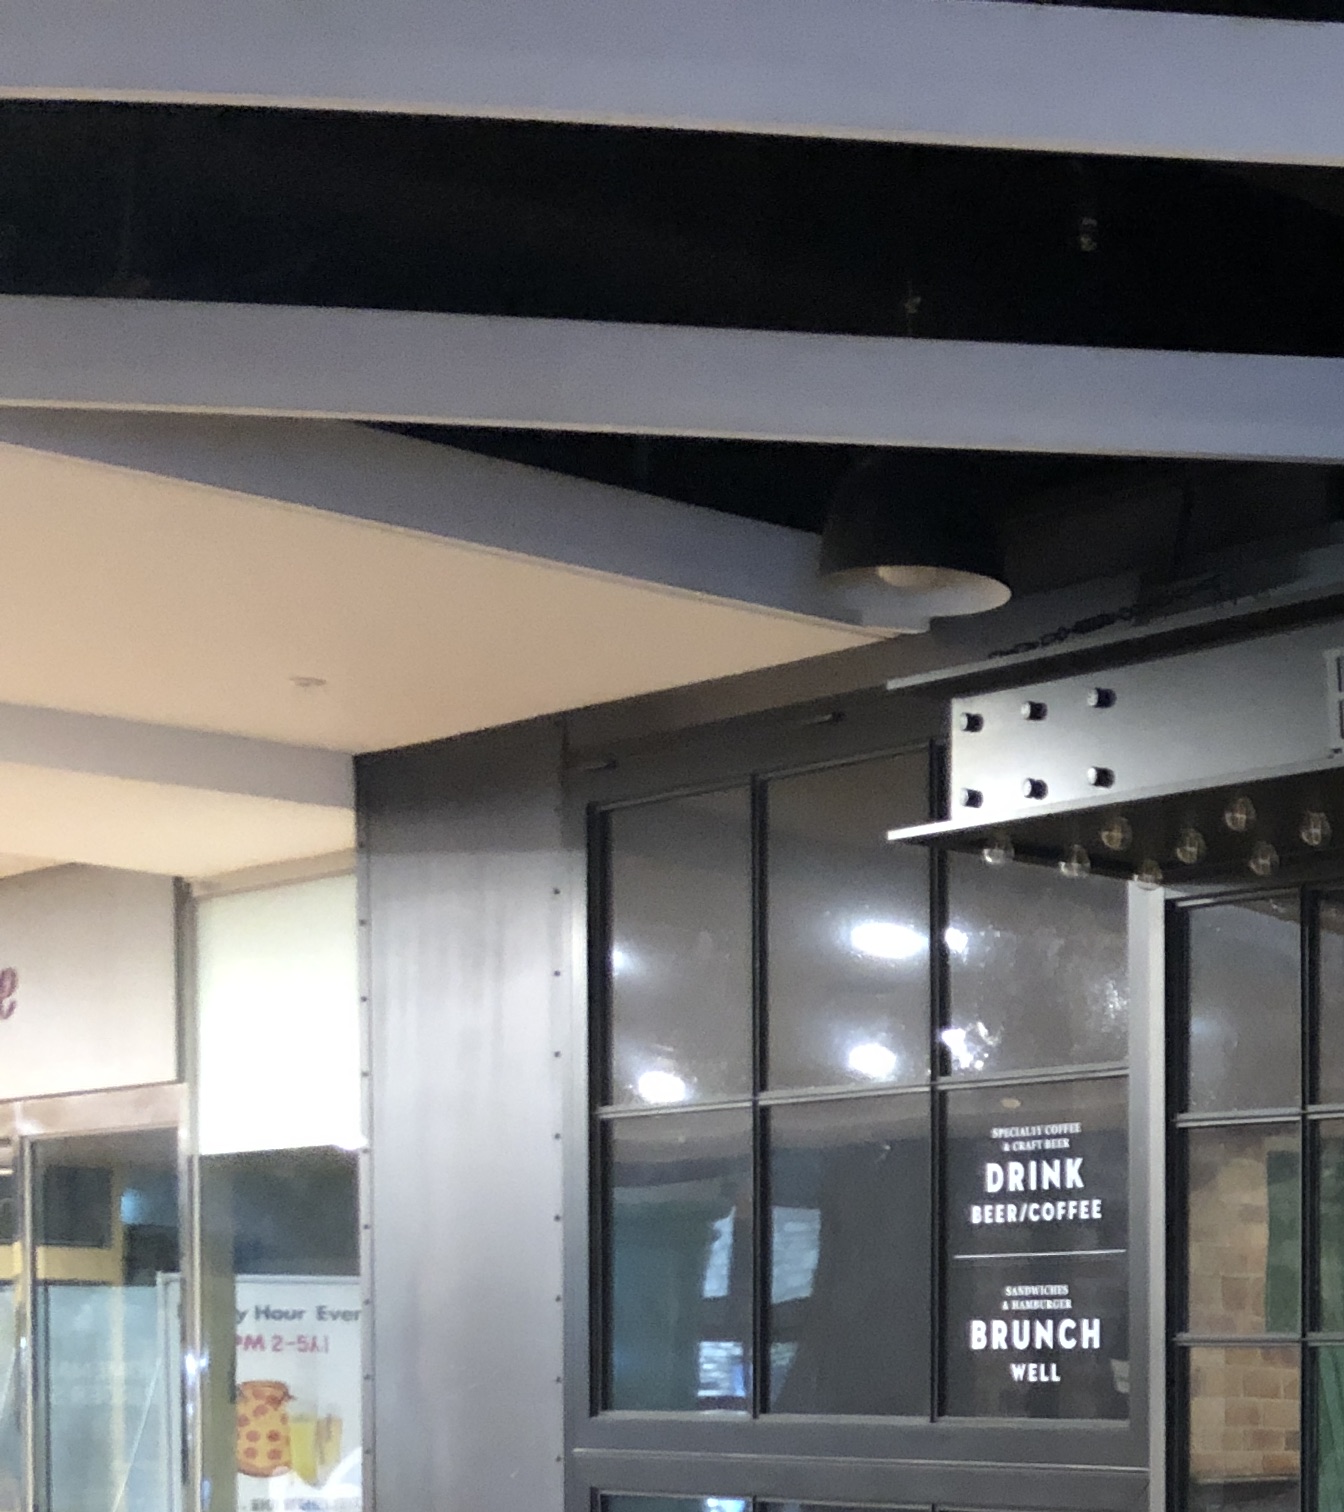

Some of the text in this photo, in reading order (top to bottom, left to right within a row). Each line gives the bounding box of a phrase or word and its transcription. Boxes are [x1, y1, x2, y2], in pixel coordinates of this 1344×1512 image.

[991, 1122, 1081, 1138] SPECIALTY COFFEE
[1012, 1140, 1042, 1151] CRAFT
[1044, 1138, 1070, 1149] BEER
[986, 1158, 1084, 1192] DRINK
[971, 1199, 1102, 1223] BEER/COFFEE
[1005, 1285, 1069, 1296] SANDWICHES
[1011, 1299, 1072, 1310] HAMBURGER
[254, 1305, 305, 1321] Hour
[971, 1319, 1100, 1349] BRUNCH
[1010, 1363, 1061, 1382] WELL
